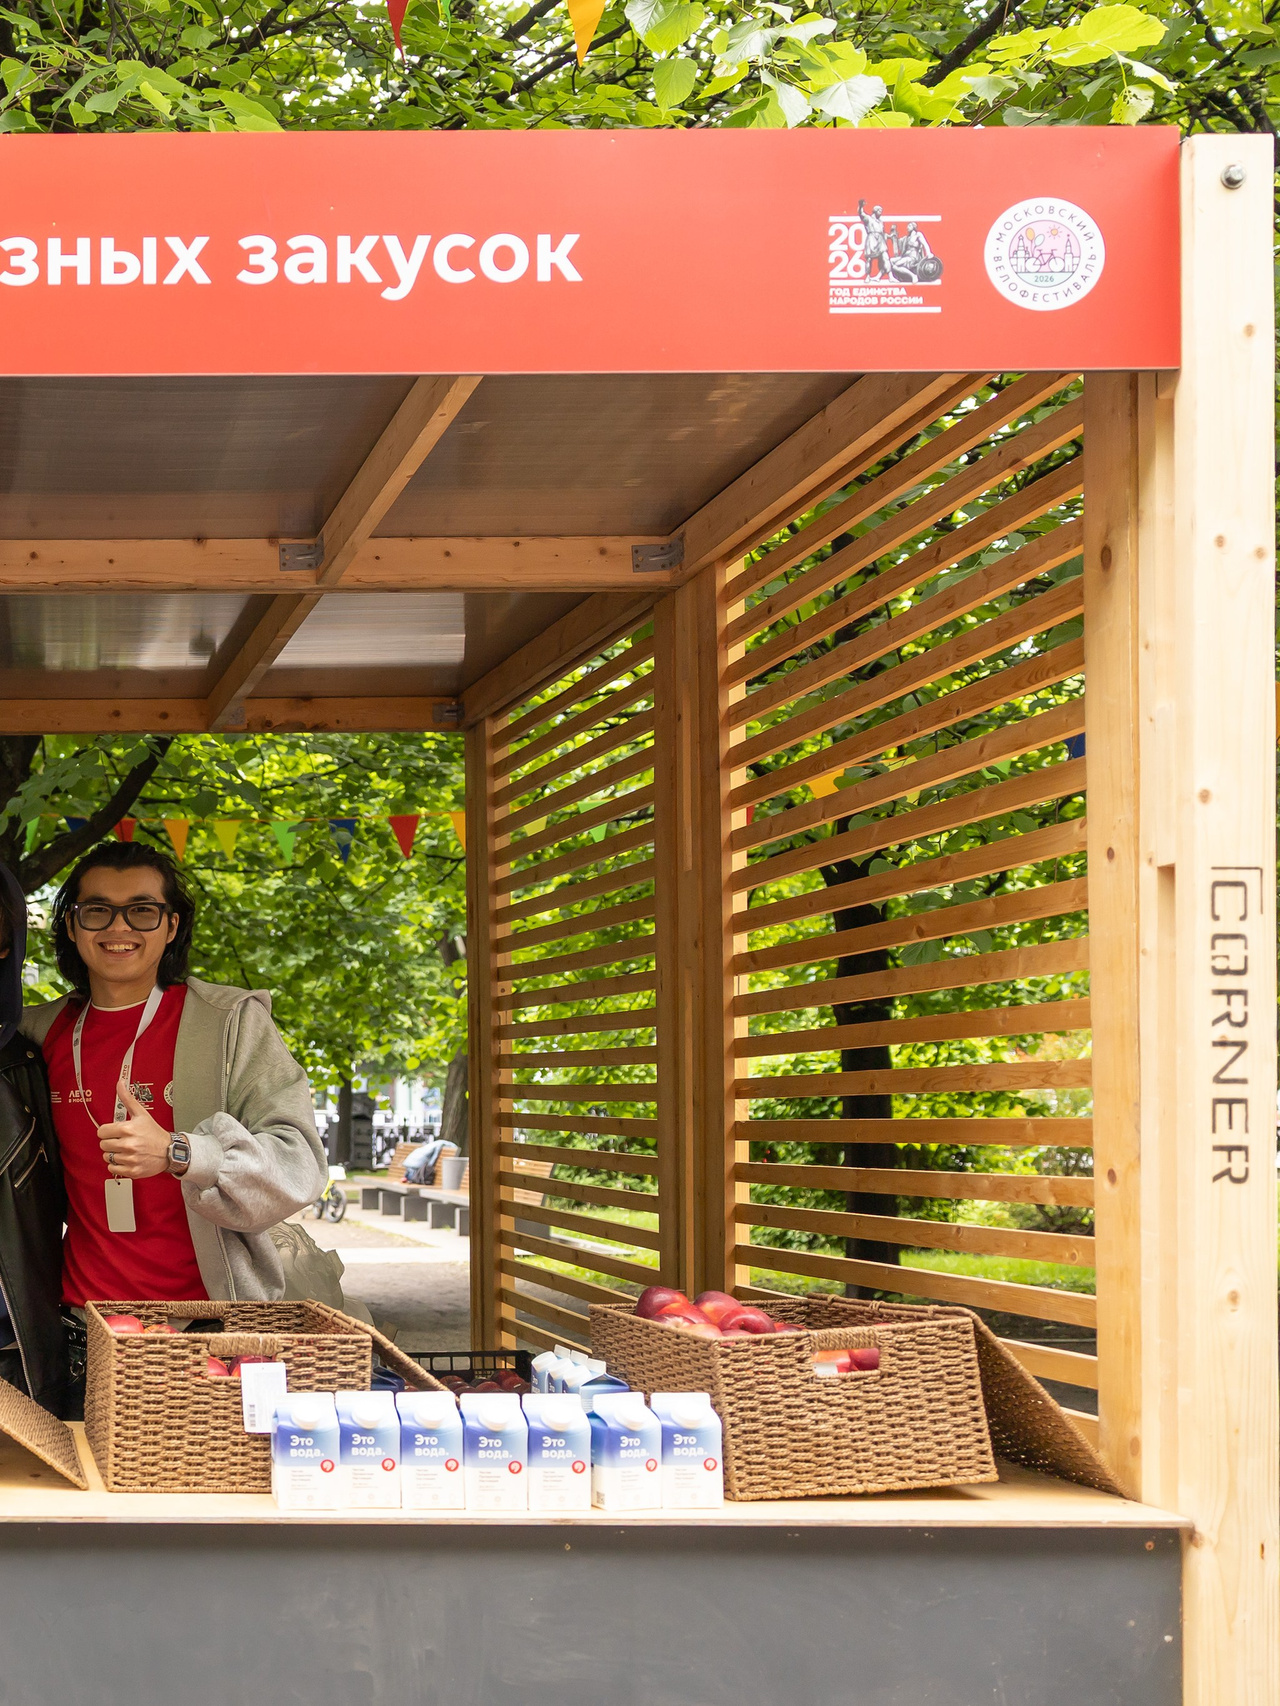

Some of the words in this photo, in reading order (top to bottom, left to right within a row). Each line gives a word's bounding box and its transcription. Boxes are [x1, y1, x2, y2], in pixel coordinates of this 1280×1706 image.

[995, 205, 1096, 244] МОСКОВСКИЙ
[828, 223, 867, 251] 20
[236, 233, 584, 301] закусок
[828, 250, 866, 278] 26
[993, 254, 1097, 303] ВЕЛОФЕСТИВАЛЬ
[1034, 275, 1055, 283] 2026
[829, 287, 851, 296] ГОД
[852, 287, 907, 296] ЕДИНСТВА
[829, 297, 878, 306] НАРОДОВ
[880, 296, 923, 304] РОССИИ
[68, 1089, 93, 1098] ЛЕО
[290, 1435, 314, 1446] Это
[352, 1434, 375, 1446] Это
[414, 1434, 438, 1446] Это
[478, 1436, 502, 1448] Это
[542, 1436, 566, 1448] Это
[620, 1435, 641, 1447] Это
[673, 1434, 696, 1446] Это
[290, 1447, 324, 1458] вода.
[352, 1447, 386, 1457] вода.
[414, 1447, 449, 1457] вода.
[478, 1449, 512, 1459] вода.
[542, 1449, 576, 1459] вода.
[620, 1448, 649, 1458] вода.
[673, 1446, 708, 1457] вода.
